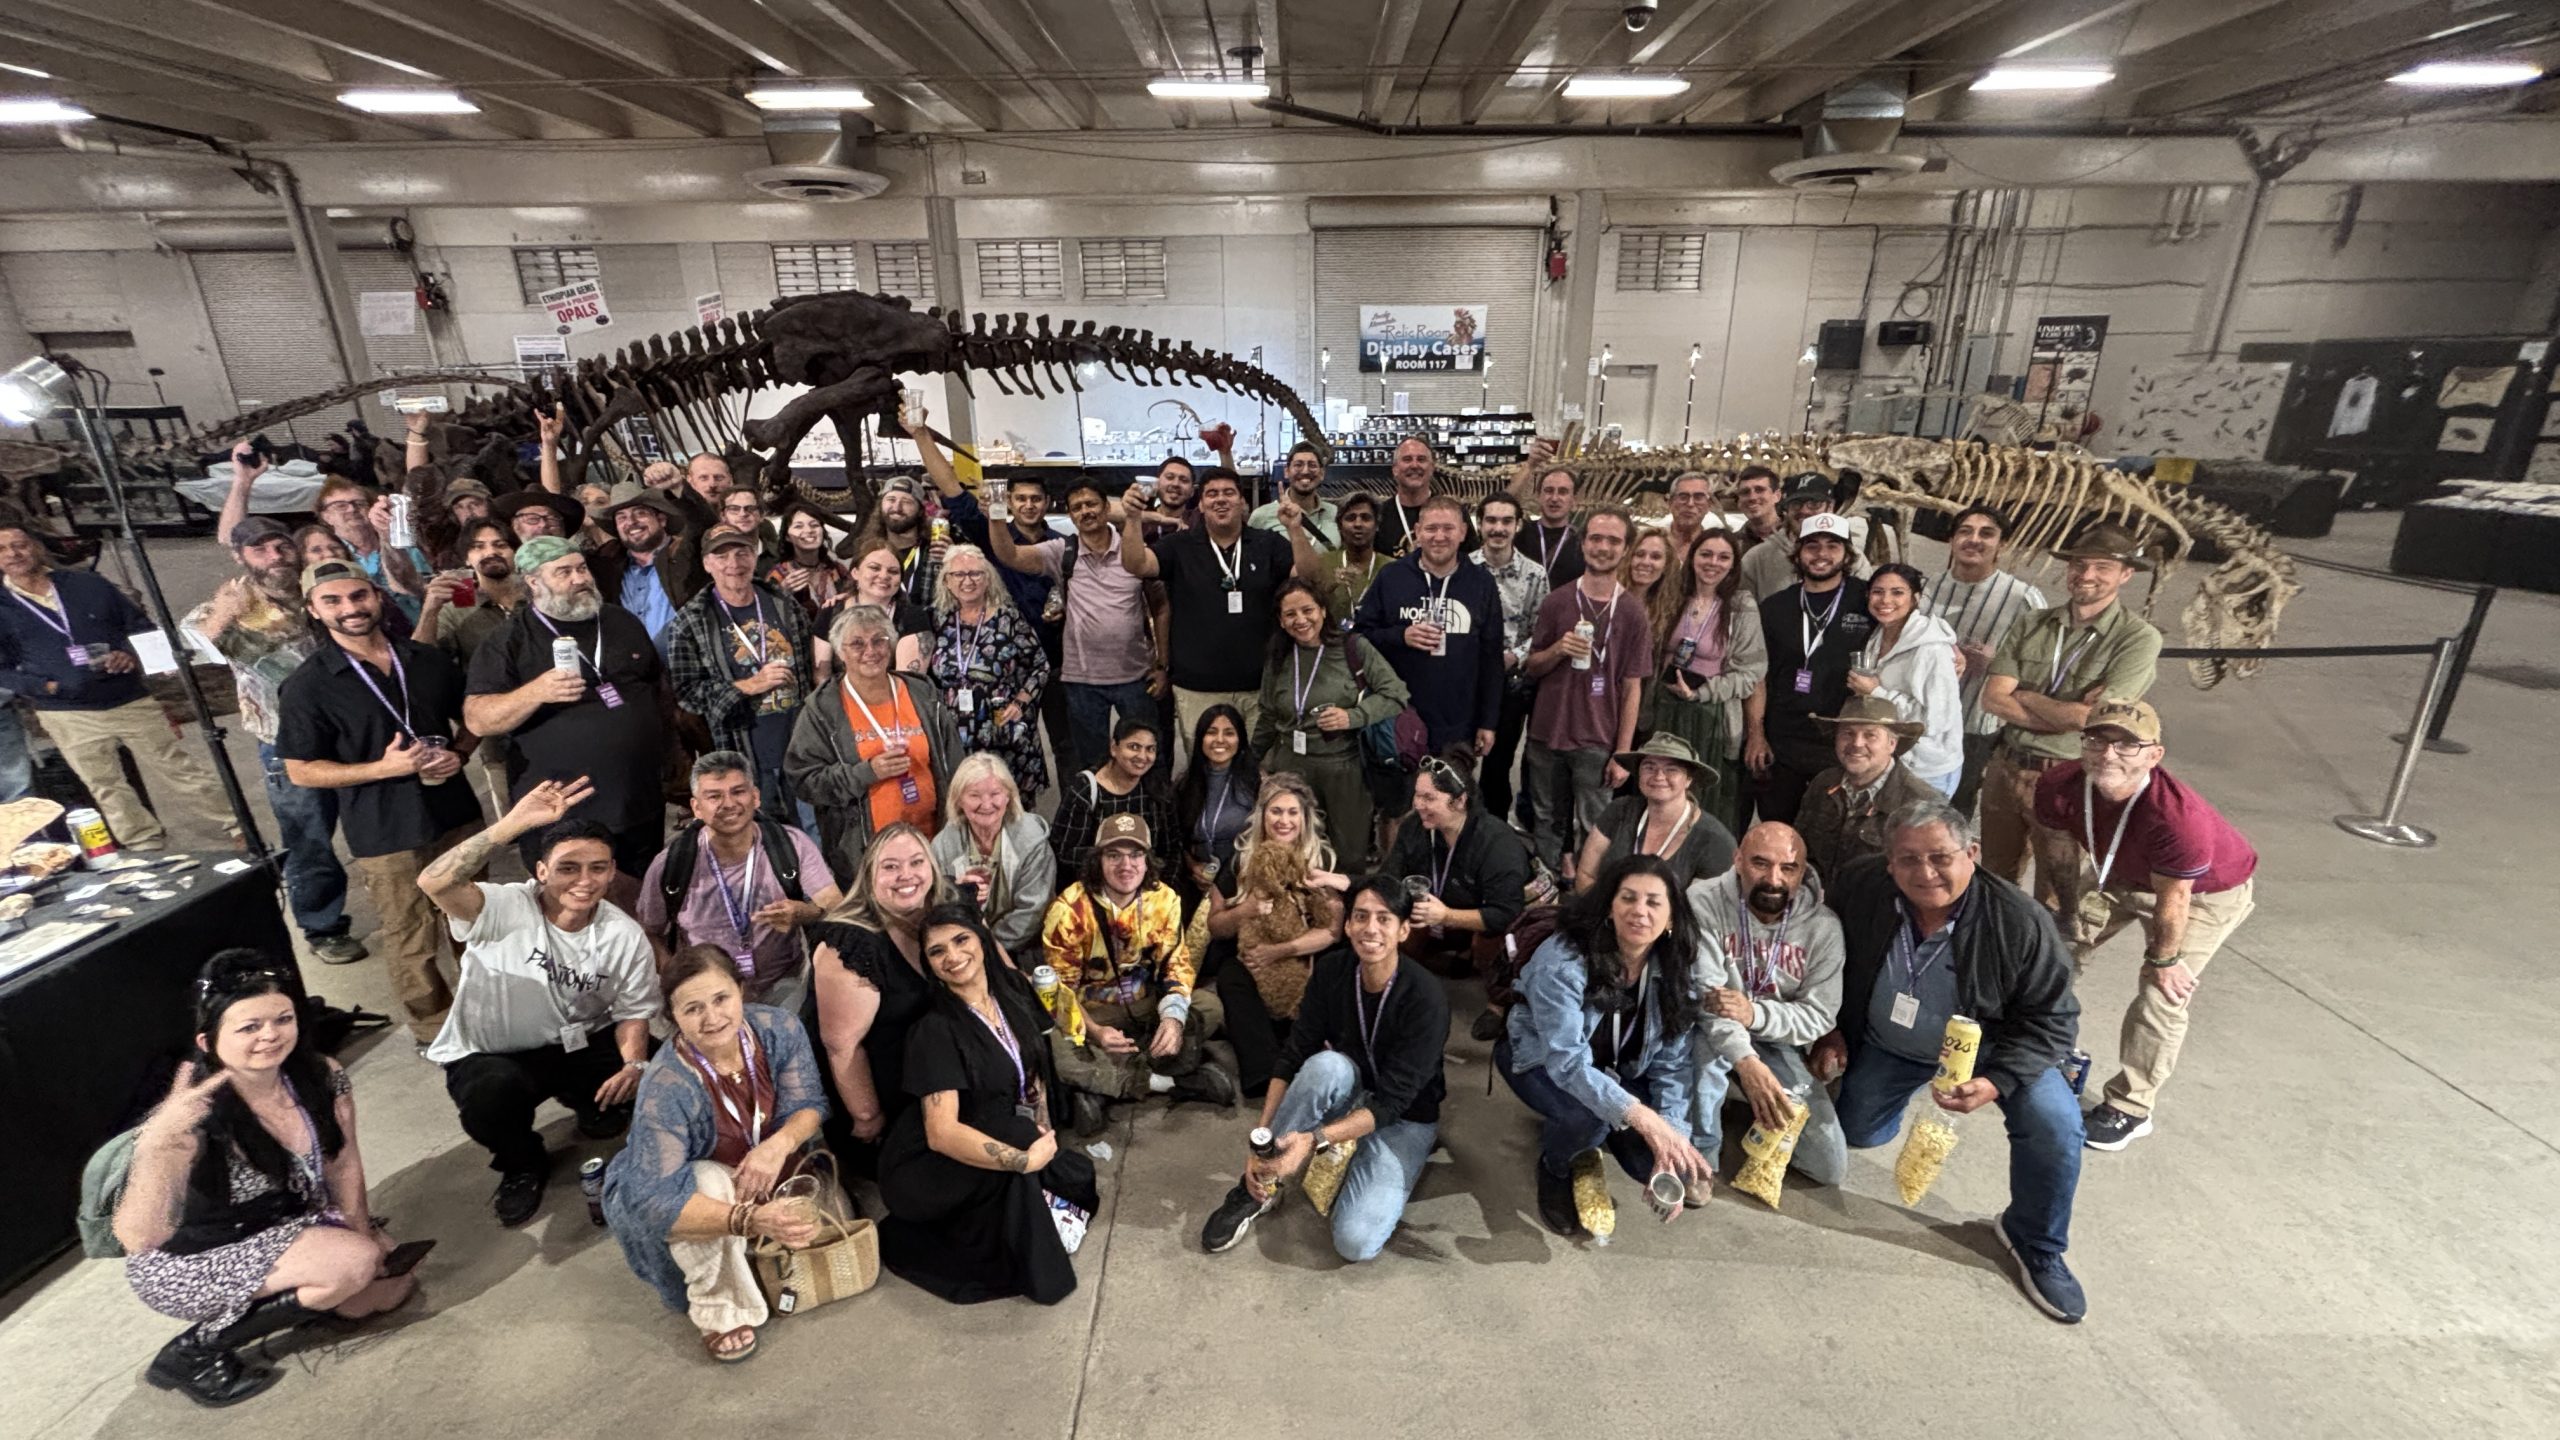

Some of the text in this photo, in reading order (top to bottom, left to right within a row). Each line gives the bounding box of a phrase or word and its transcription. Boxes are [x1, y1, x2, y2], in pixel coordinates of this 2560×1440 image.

[542, 283, 596, 304] ETHIOPIAN GEMS
[557, 303, 598, 323] OPALS
[1381, 324, 1450, 340] Relic Room
[1366, 341, 1478, 359] Display Cases
[1395, 360, 1426, 369] ROOM
[1428, 360, 1447, 369] 117
